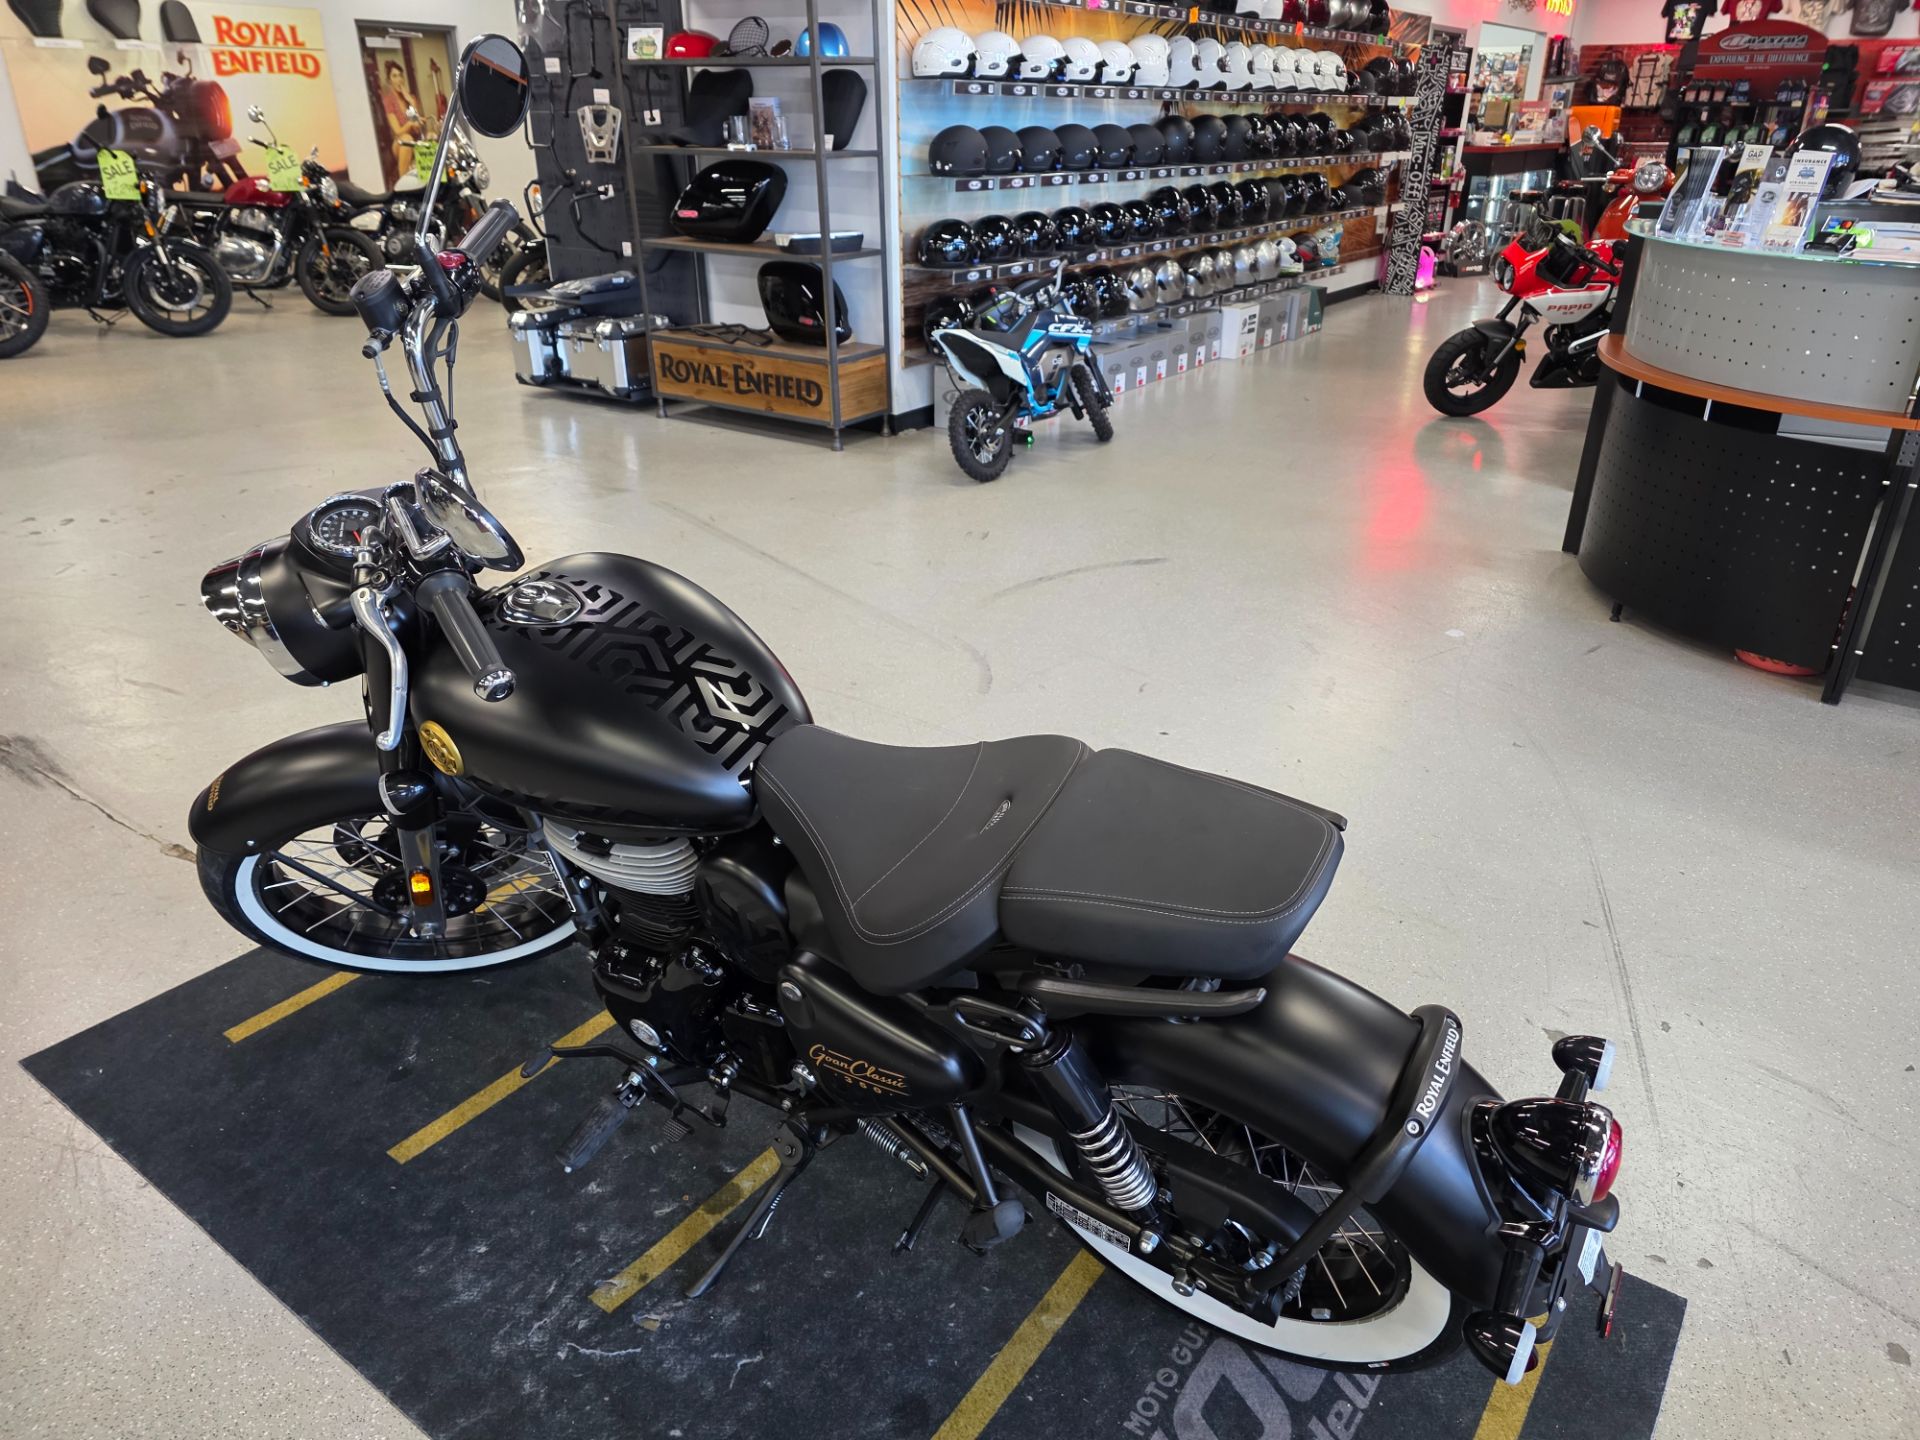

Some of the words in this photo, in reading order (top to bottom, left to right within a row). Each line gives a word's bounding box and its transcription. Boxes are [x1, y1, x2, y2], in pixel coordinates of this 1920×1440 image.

[212, 15, 305, 47] ROYAL
[211, 50, 321, 78] ENFIELD
[1710, 55, 1750, 65] EXPERIENCE
[1767, 53, 1810, 63] DIFFERENCE
[103, 160, 133, 180] SALE
[267, 154, 298, 174] SALE
[1407, 134, 1429, 199] Muc-Off
[1547, 303, 1593, 311] PAPIO
[659, 352, 728, 389] ROYAL
[732, 363, 824, 407] ENFIELD
[809, 1044, 851, 1069] Goan
[850, 1060, 908, 1088] Classic
[1415, 1074, 1446, 1118] ROYAL
[1434, 1028, 1460, 1076] ENFIELD
[843, 1076, 882, 1094] 350
[1122, 1367, 1179, 1437] MOTO
